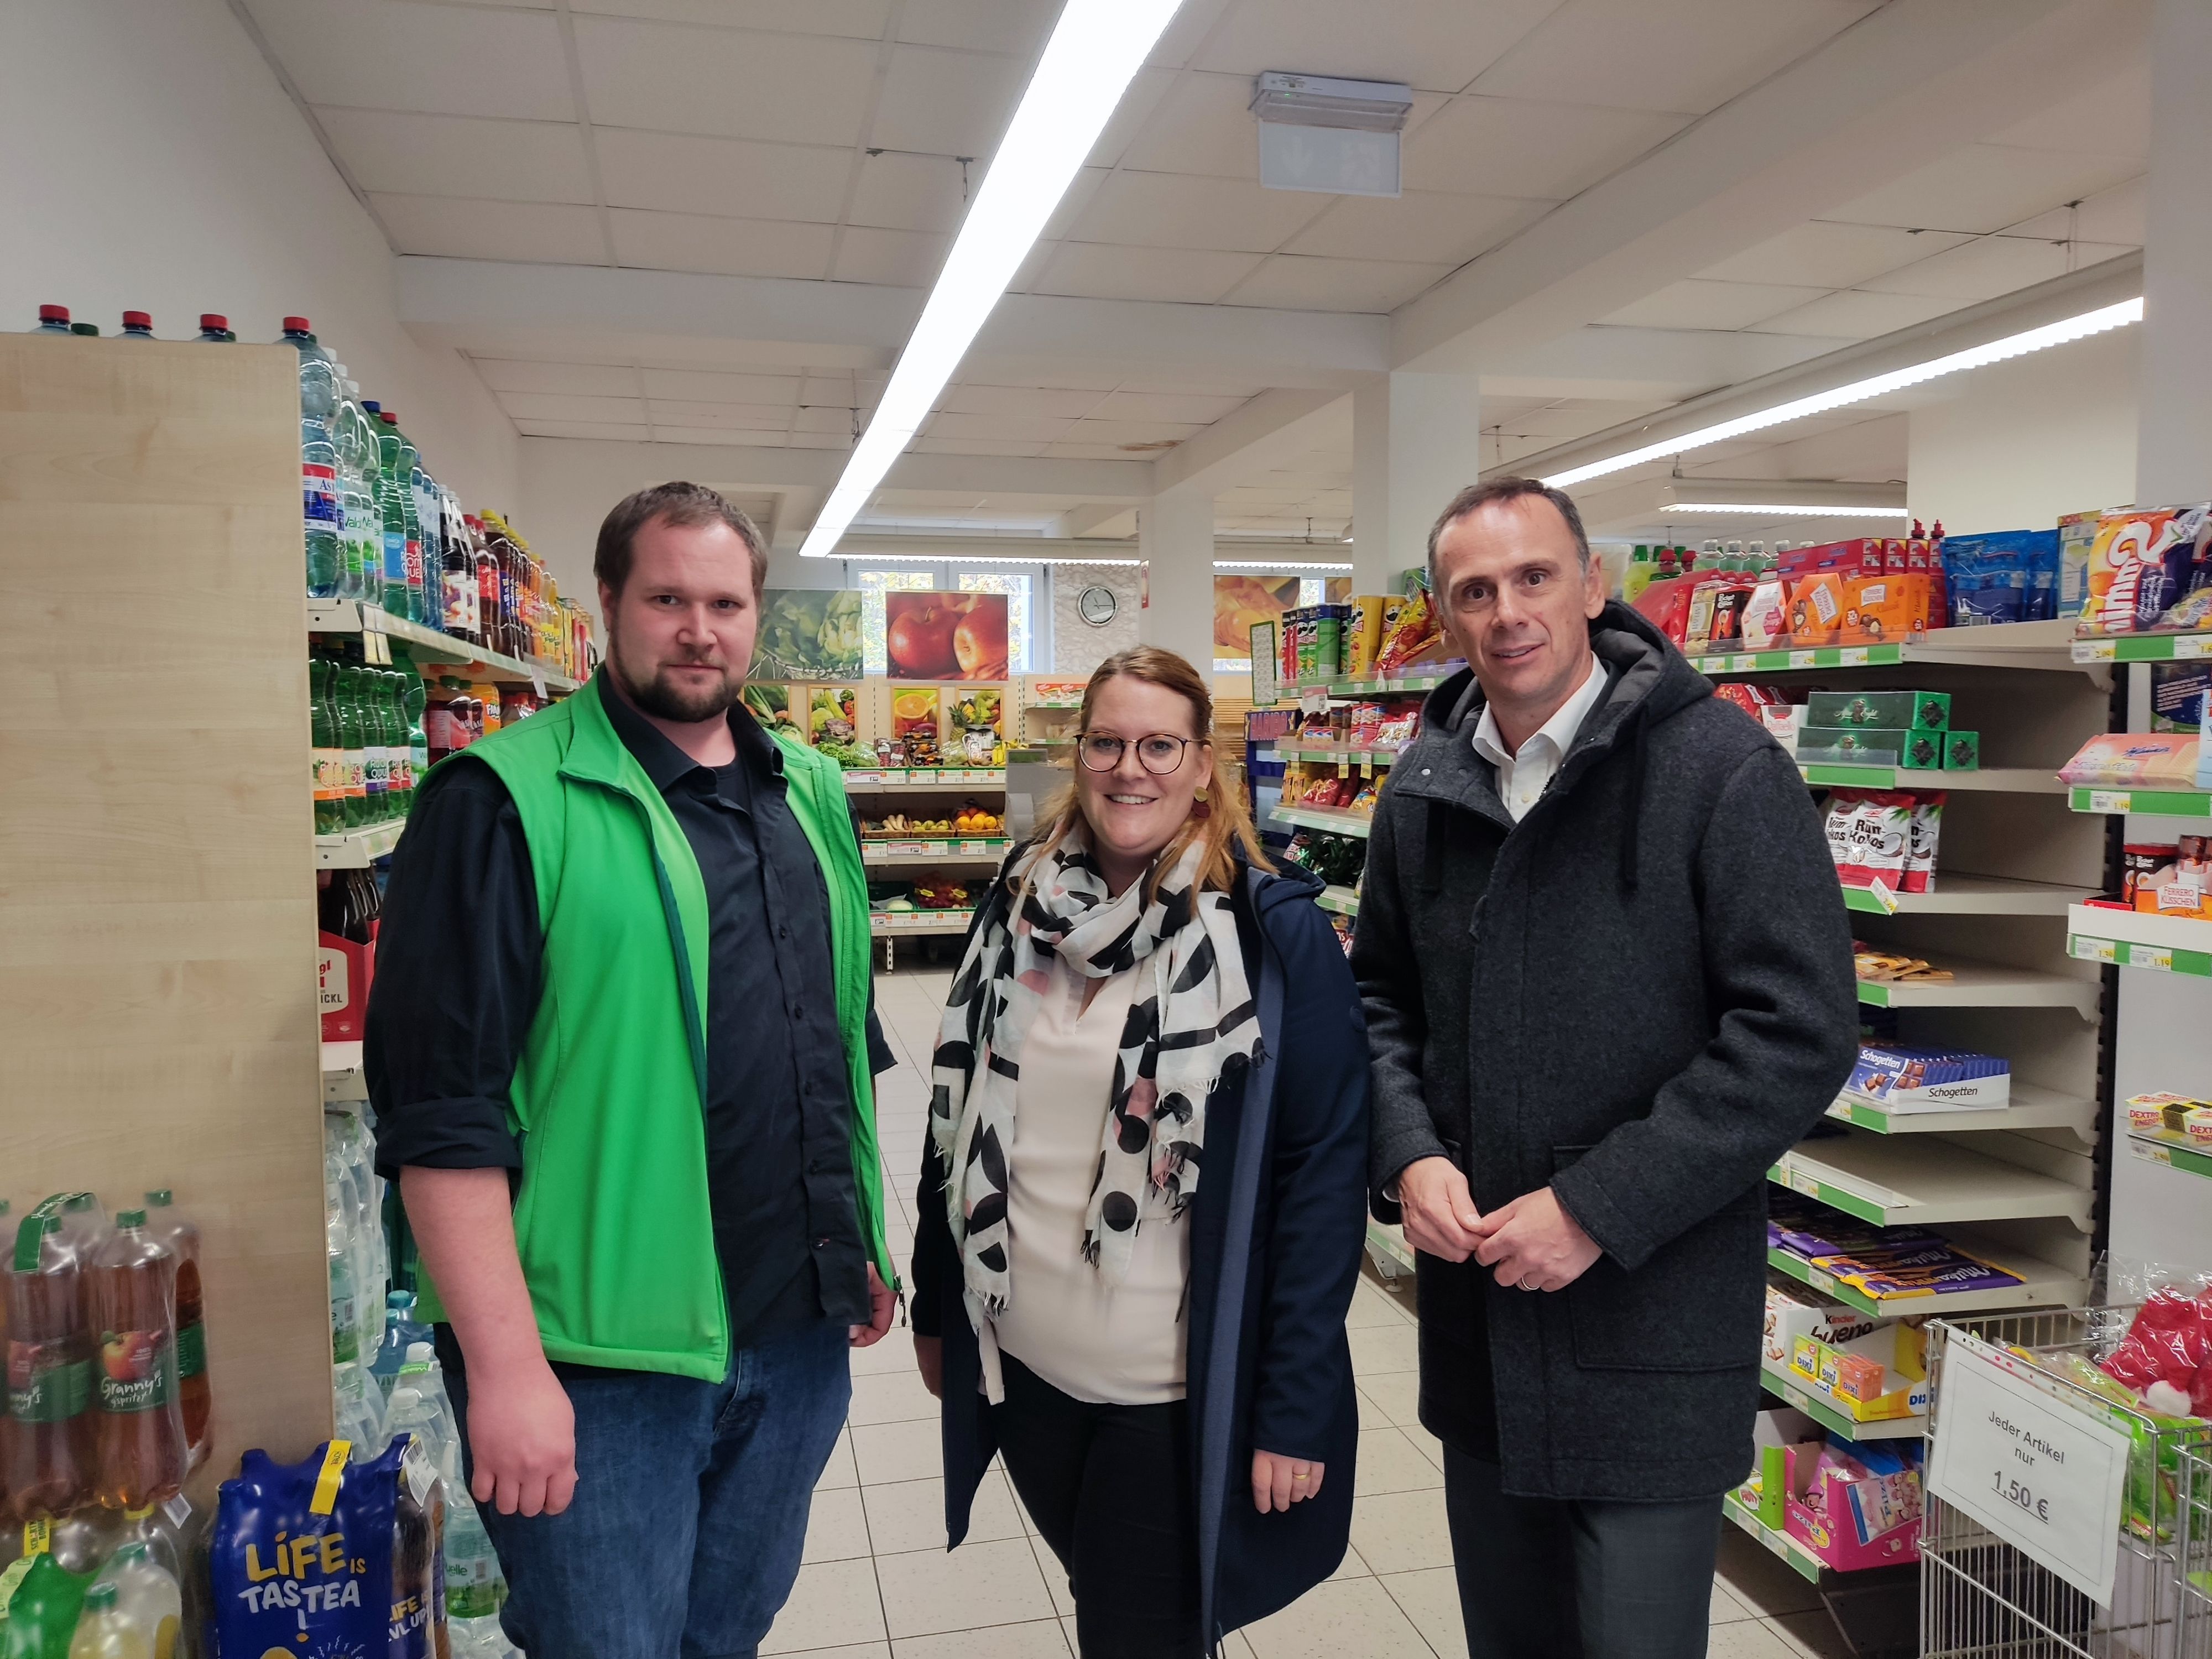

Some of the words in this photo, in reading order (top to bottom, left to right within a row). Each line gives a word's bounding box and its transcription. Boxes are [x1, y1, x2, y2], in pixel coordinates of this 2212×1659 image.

[1250, 712, 1287, 741] HARIBO
[2164, 886, 2194, 897] FERRERO
[1860, 1050, 1901, 1069] Schogetten
[1928, 1087, 1978, 1099] Schogetten
[1901, 1250, 1951, 1265] Milka
[1937, 1266, 1990, 1281] Milka
[1810, 1322, 1873, 1344] bueno
[101, 1369, 163, 1400] Granny's
[1989, 1411, 2021, 1438] Jeder
[2023, 1432, 2064, 1464] Artikel
[2015, 1447, 2035, 1466] nur
[1994, 1470, 2031, 1508] 1,50
[2037, 1499, 2048, 1521] €
[350, 1557, 367, 1574] IS
[238, 1579, 361, 1613] TASTEA
[390, 1595, 419, 1622] IFE
